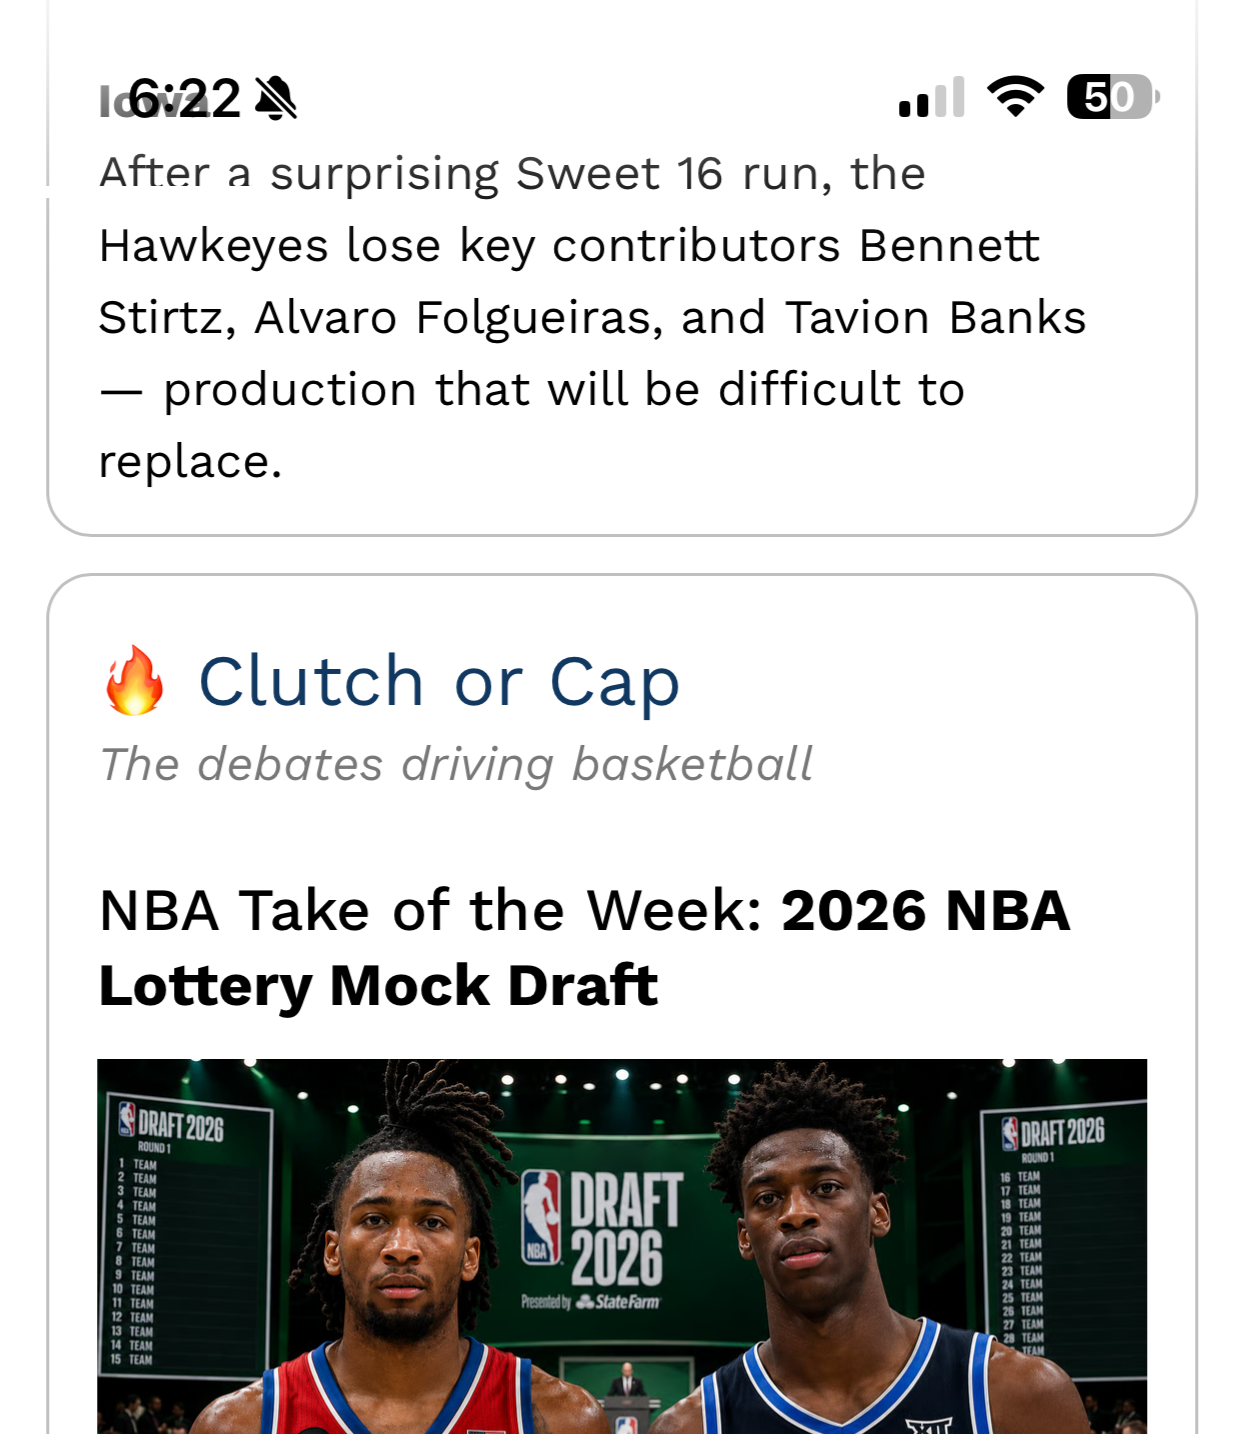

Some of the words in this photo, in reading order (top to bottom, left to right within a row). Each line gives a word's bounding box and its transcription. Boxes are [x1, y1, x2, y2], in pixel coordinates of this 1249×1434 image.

[129, 77, 241, 119] 6:22
[1085, 81, 1135, 113] 50
[99, 154, 210, 186] After
[229, 164, 250, 186] a
[271, 155, 499, 200] surprising
[517, 157, 660, 190] Sweet
[678, 157, 722, 190] 16
[745, 164, 830, 196] run,
[850, 154, 924, 190] the
[102, 226, 327, 272] Hawkeyes
[349, 226, 439, 262] lose
[462, 226, 536, 272] key
[554, 226, 839, 262] contributors
[862, 229, 1040, 262] Bennett
[99, 299, 235, 340] Stirtz,
[254, 298, 396, 334] Alvaro
[419, 298, 662, 344] Folgueiras,
[683, 298, 763, 334] and
[785, 299, 927, 334] Tavion
[952, 298, 1085, 334] Banks
[166, 370, 414, 415] production
[435, 370, 530, 406] that
[547, 370, 629, 406] will
[647, 370, 699, 406] be
[720, 369, 901, 406] difficult
[918, 374, 964, 406] to
[101, 442, 280, 487] replace.
[201, 652, 421, 706] Clutch
[456, 668, 523, 706] or
[552, 657, 678, 720] Cap
[102, 745, 178, 780] The
[199, 745, 382, 781] debates
[403, 745, 553, 790] driving
[573, 745, 812, 781] basketball
[103, 890, 219, 930] NBA
[239, 886, 368, 931] Take
[394, 886, 450, 931] of
[469, 886, 563, 931] the
[587, 886, 759, 931] Week:
[782, 890, 925, 931] 2026
[948, 890, 1071, 930] NBA
[101, 965, 313, 1018] Lottery
[332, 962, 491, 1006] Mock
[510, 961, 658, 1006] Draft
[138, 1109, 185, 1139] DRAFT
[186, 1114, 224, 1143] 2026
[1021, 1120, 1066, 1148] DRAFT
[1067, 1116, 1105, 1145] 2026
[138, 1140, 166, 1154] ROUND
[166, 1143, 171, 1155] 1
[119, 1157, 125, 1169] 1
[134, 1158, 157, 1171] TEAM
[1021, 1152, 1049, 1164] ROUND
[1050, 1151, 1055, 1163] 1
[117, 1171, 125, 1182] 2
[133, 1172, 157, 1185] TEAM
[1000, 1172, 1011, 1183] 16
[1018, 1170, 1041, 1182] TEAM
[117, 1184, 124, 1196] 3
[133, 1186, 157, 1199] TEAM
[117, 1199, 124, 1210] 4
[132, 1200, 156, 1212] TEAM
[570, 1171, 684, 1228] DRAFT
[1001, 1198, 1012, 1210] 18
[1018, 1197, 1041, 1209] TEAM
[117, 1213, 124, 1224] 5
[132, 1214, 156, 1226] TEAM
[116, 1227, 123, 1238] 6
[132, 1228, 156, 1240] TEAM
[1000, 1225, 1013, 1237] 20
[1019, 1224, 1042, 1236] TEAM
[116, 1241, 123, 1252] 7
[132, 1242, 155, 1254] TEAM
[526, 1242, 548, 1260] NBA
[115, 1255, 123, 1266] 8
[131, 1256, 155, 1268] TEAM
[571, 1229, 663, 1287] 2026
[1001, 1252, 1013, 1264] 22
[1019, 1251, 1043, 1263] TEAM
[115, 1269, 122, 1280] 9
[131, 1270, 155, 1282] TEAM
[112, 1283, 123, 1294] 10
[131, 1284, 155, 1296] TEAM
[1002, 1279, 1014, 1290] 24
[1020, 1278, 1043, 1289] TEAM
[112, 1297, 122, 1308] 11
[130, 1297, 154, 1309] TEAM
[521, 1294, 561, 1310] Presented
[562, 1293, 572, 1312] by
[111, 1311, 123, 1322] 12
[130, 1311, 154, 1323] TEAM
[1002, 1305, 1015, 1317] 26
[1021, 1305, 1044, 1316] TEAM
[111, 1325, 122, 1336] 13
[130, 1325, 153, 1337] TEAM
[111, 1339, 122, 1350] 14
[129, 1340, 153, 1351] TEAM
[110, 1353, 122, 1365] 15
[129, 1354, 153, 1365] TEAM
